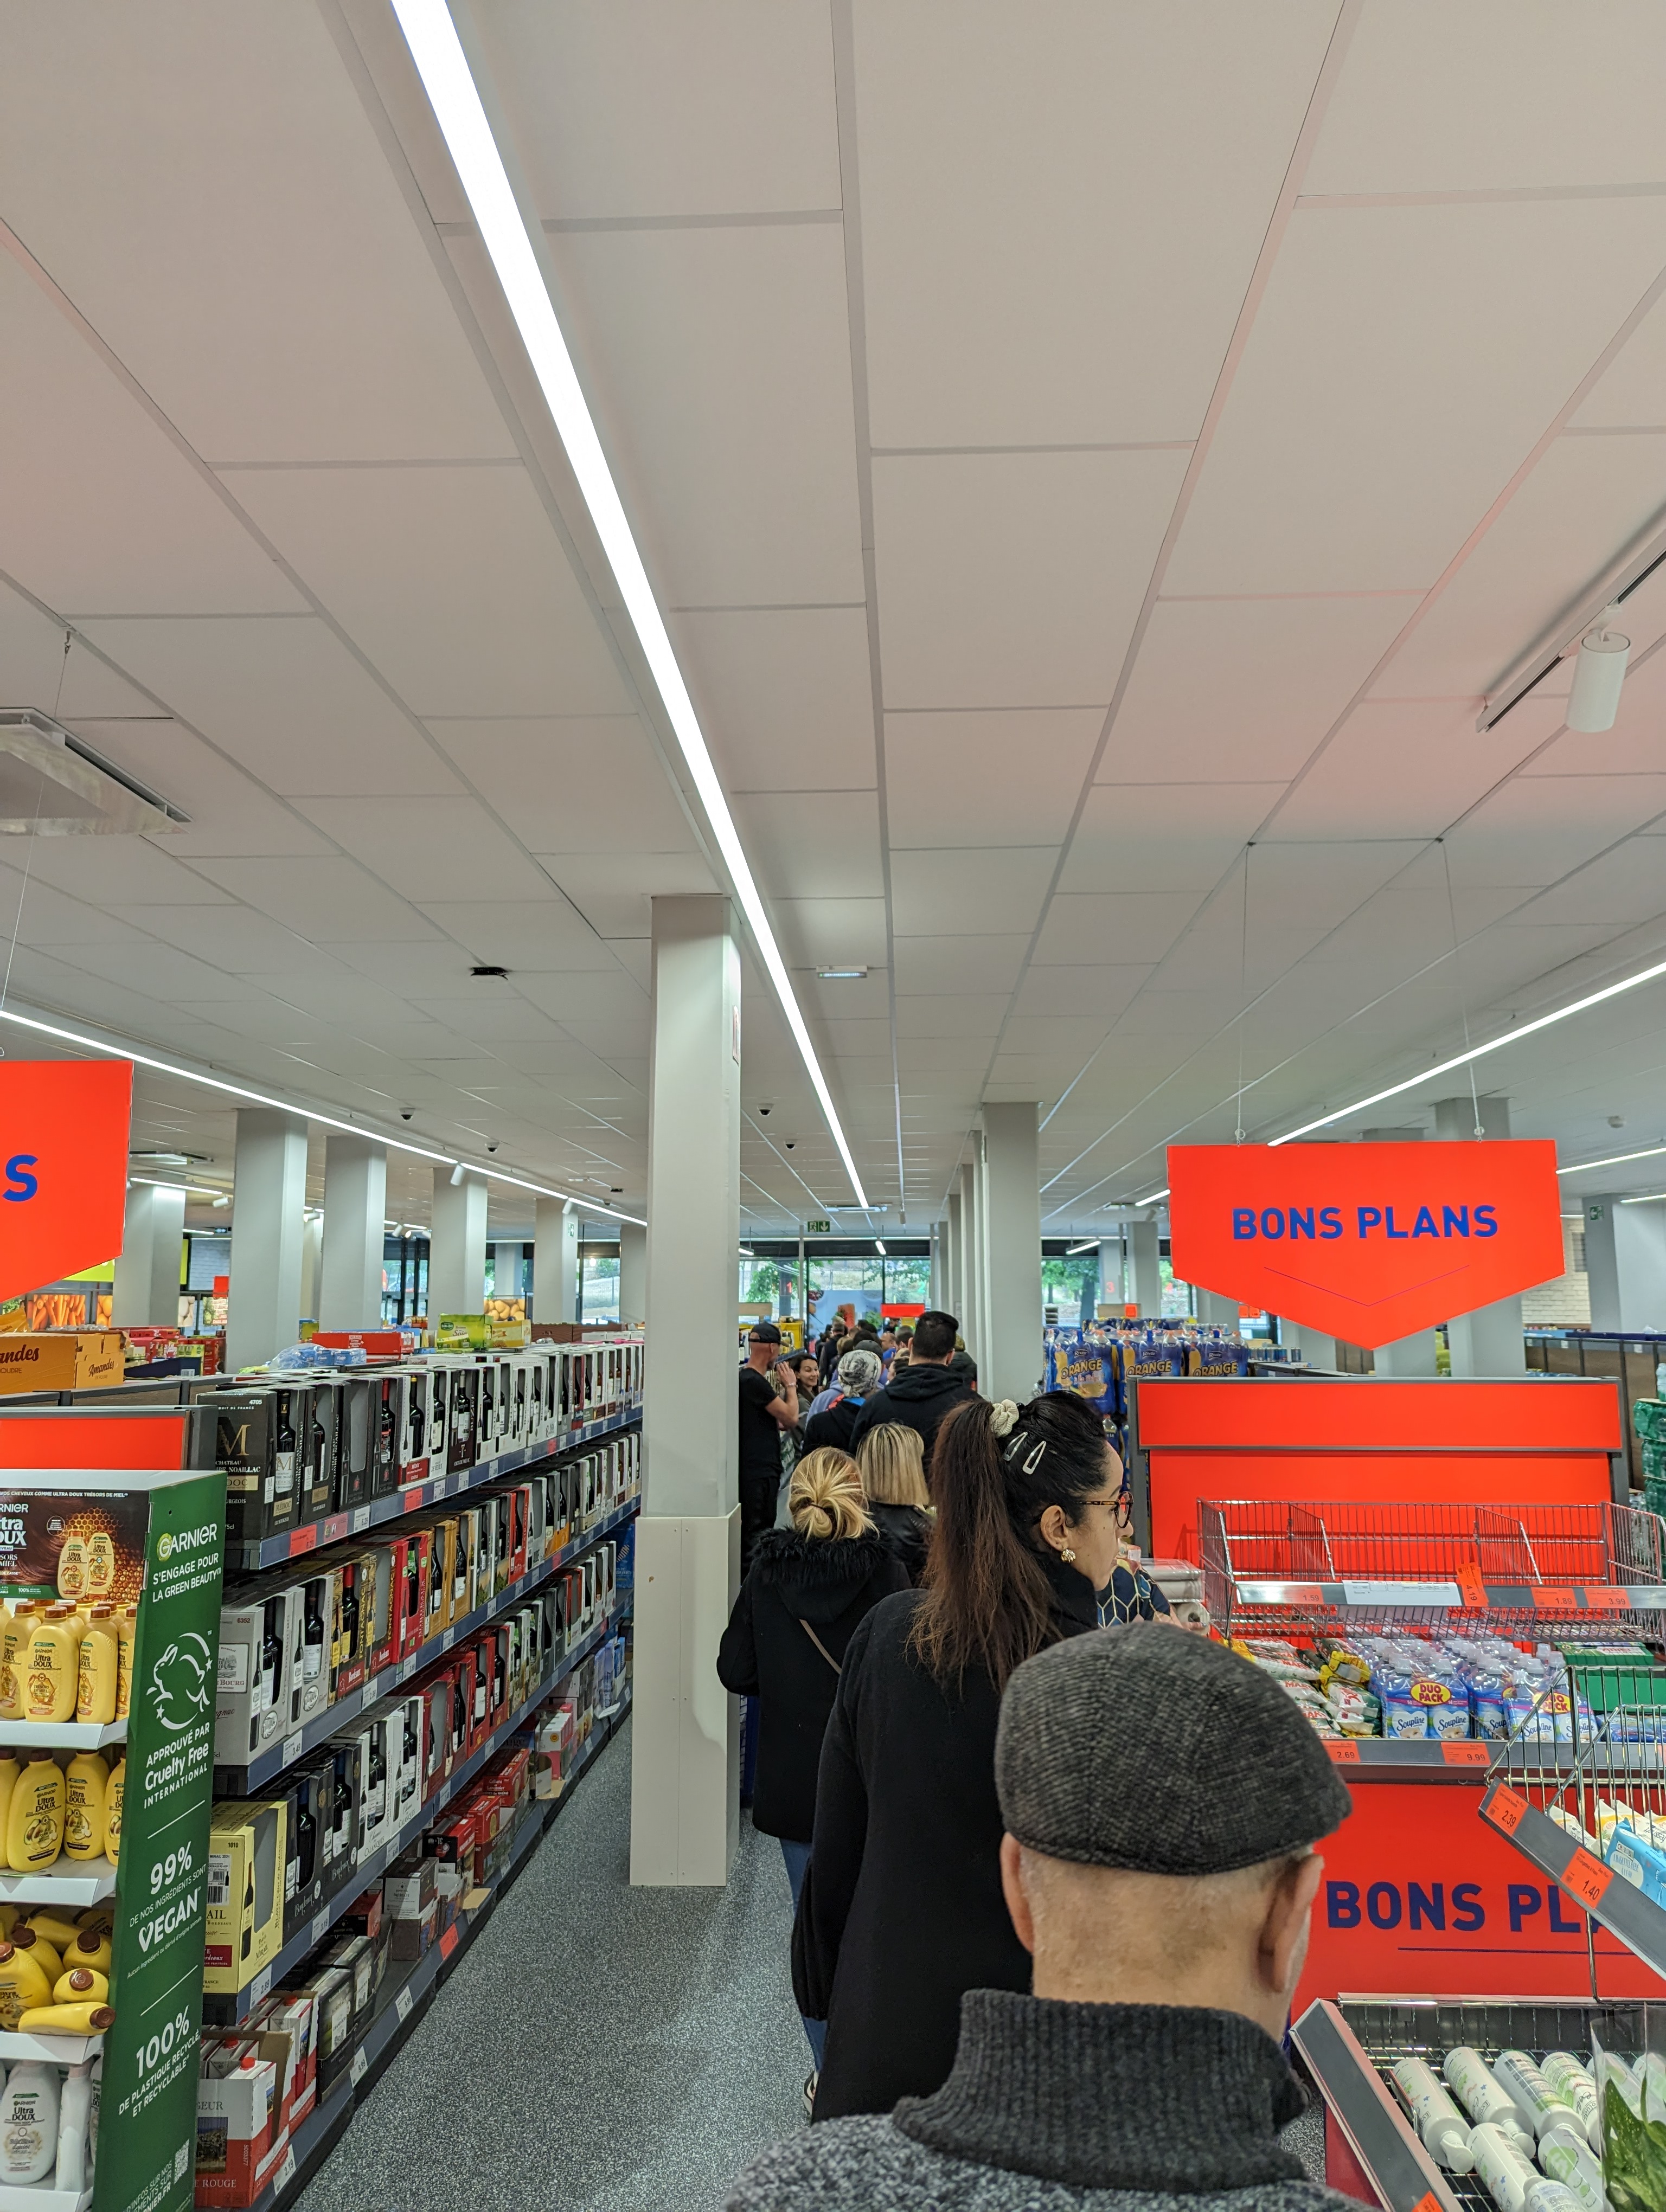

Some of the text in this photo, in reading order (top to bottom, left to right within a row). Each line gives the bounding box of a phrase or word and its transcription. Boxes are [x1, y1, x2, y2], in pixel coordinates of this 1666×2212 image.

[1233, 1204, 1499, 1240] BONS PLANS
[88, 1358, 115, 1377] Amandes
[1061, 1357, 1103, 1379] ORANGE
[1126, 1359, 1172, 1377] ORANGE
[1193, 1361, 1239, 1377] ORANGE
[159, 1523, 218, 1558] GARNIER
[153, 1552, 219, 1585] S'ENGAGE POUR
[152, 1589, 164, 1603] LA
[165, 1580, 190, 1598] GREEN
[1466, 1585, 1477, 1602] 4.19
[34, 1660, 52, 1669] DOUX
[1419, 1693, 1444, 1702] PACK
[1420, 1684, 1441, 1694] DUO
[1396, 1716, 1425, 1732] Soupline
[1438, 1716, 1466, 1732] Soupline
[146, 1722, 210, 1769] APPROUVÉ PAR
[145, 1742, 209, 1791] Cruelty Free
[1467, 1754, 1486, 1762] 9.99
[70, 1790, 85, 1798] Ultra
[144, 1763, 208, 1810] INTERNATIONAL
[35, 1802, 55, 1813] DOUX
[37, 1797, 54, 1805] Ultra
[69, 1796, 86, 1804] DOUX
[399, 1809, 415, 1828] CALANQUES
[1501, 1810, 1516, 1827] 2.39
[364, 1834, 385, 1855] CALANQUES
[150, 1841, 192, 1895] 99%
[130, 1863, 207, 1928] DE NOS INGRÉDIENTS SONT
[1582, 1880, 1601, 1900] 1.40
[206, 1909, 227, 1919] AIL
[1327, 1880, 1600, 1933] BONS PL
[136, 2004, 190, 2079] 100%
[119, 2097, 130, 2115] DE
[131, 2059, 171, 2105] PLASTIQUE
[133, 2100, 142, 2118] ET
[150, 2174, 162, 2190] SUR
[161, 2159, 172, 2178] NOS
[284, 2159, 294, 2176] 2.19
[160, 2170, 172, 2189] SUR
[202, 2179, 236, 2188] ROUGE
